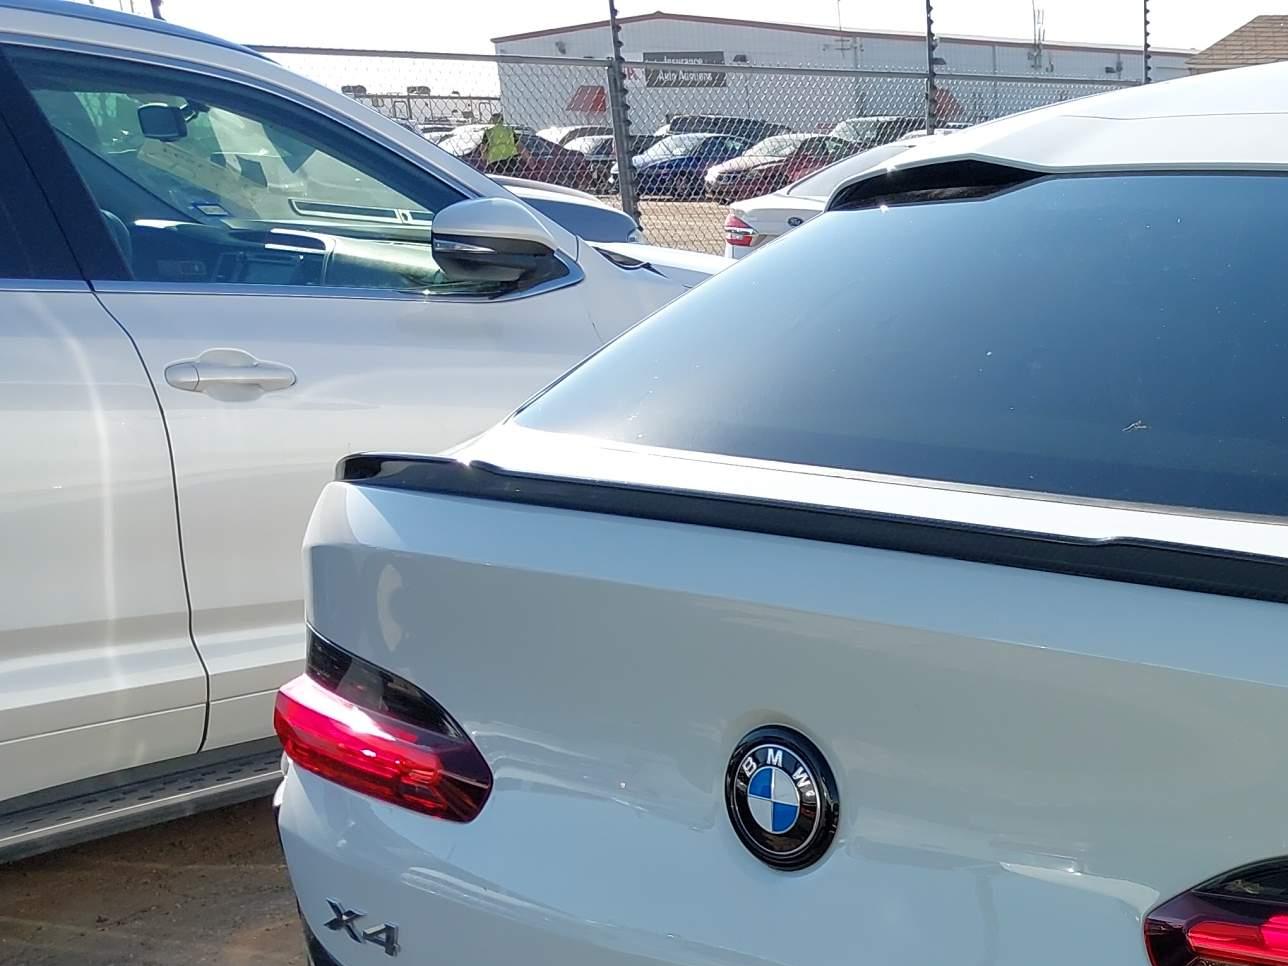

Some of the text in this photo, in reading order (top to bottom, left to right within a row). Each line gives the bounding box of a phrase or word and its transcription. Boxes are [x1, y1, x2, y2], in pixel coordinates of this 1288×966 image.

[658, 70, 676, 81] Auto
[742, 748, 811, 788] BMW
[323, 897, 400, 956] X4
